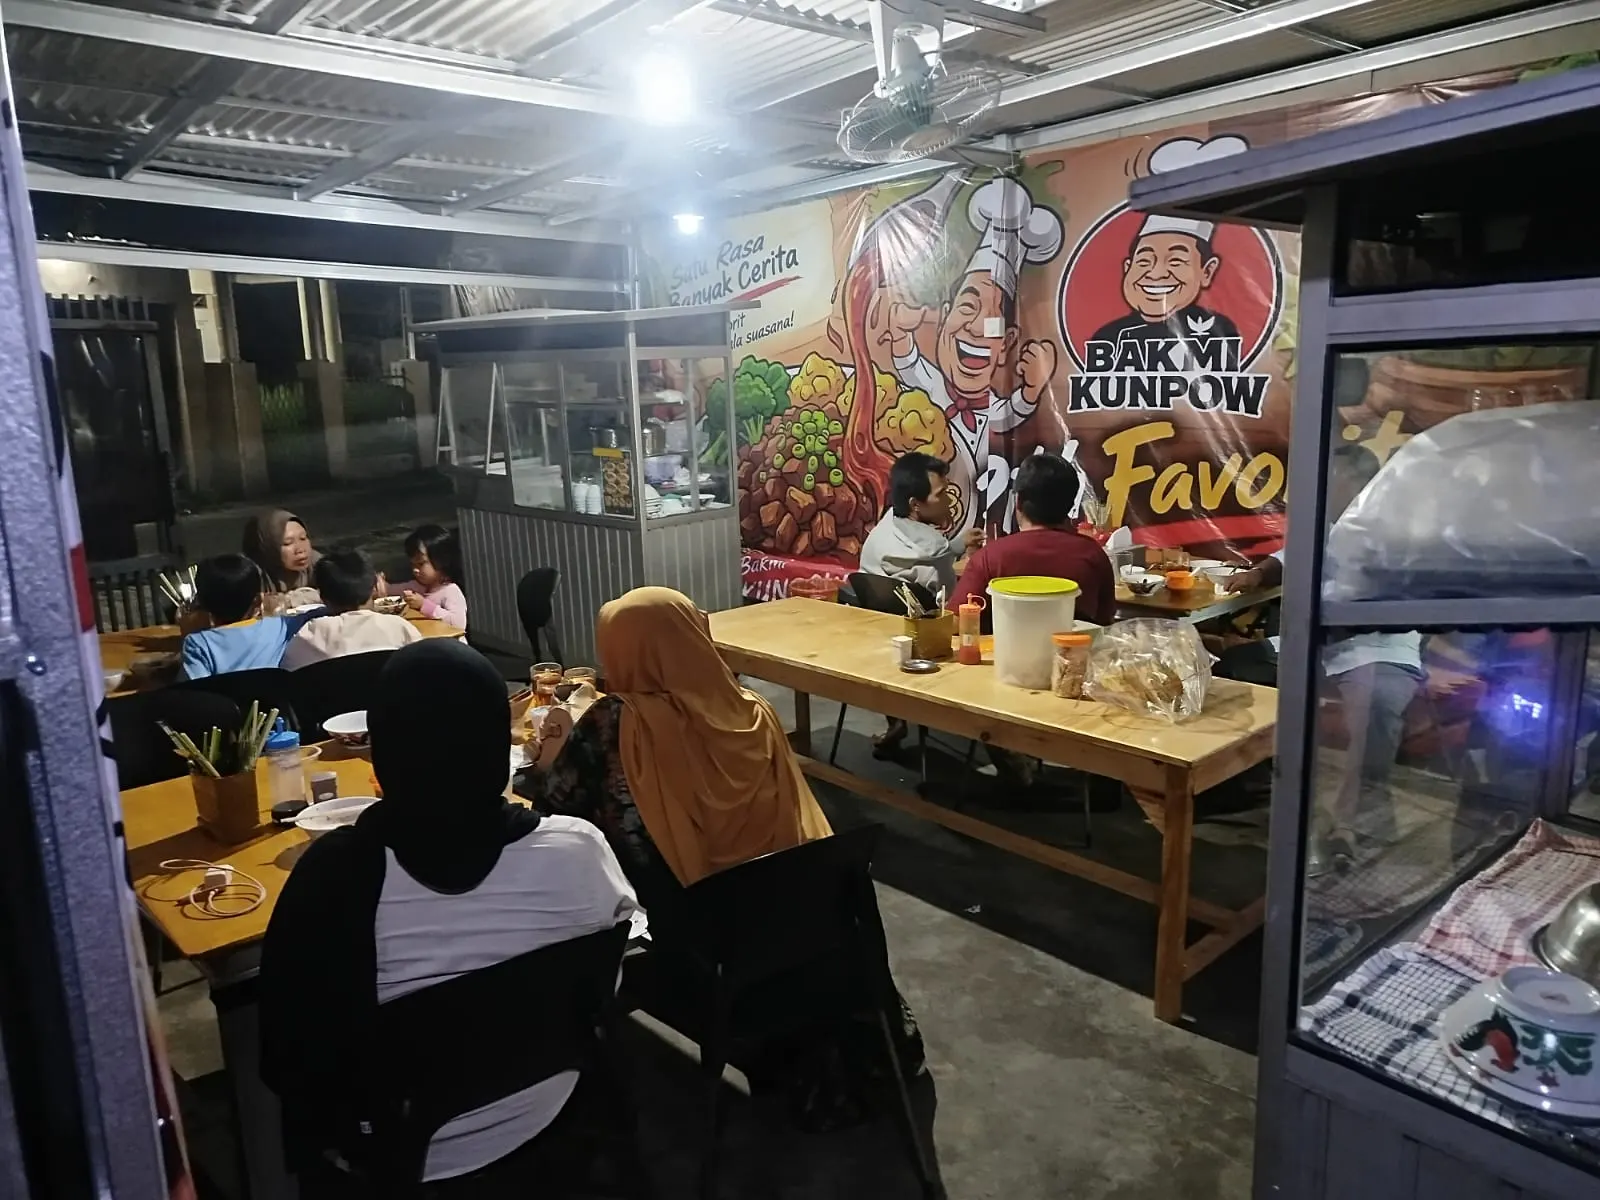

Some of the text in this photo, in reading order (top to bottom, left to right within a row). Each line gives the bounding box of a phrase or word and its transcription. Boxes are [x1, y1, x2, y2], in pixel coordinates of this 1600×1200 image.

[670, 235, 765, 290] Satu Rasa
[738, 244, 799, 290] Cerita
[745, 310, 794, 343] suasana!
[1085, 338, 1241, 372] BAKMI
[1069, 375, 1270, 417] KUNPOW
